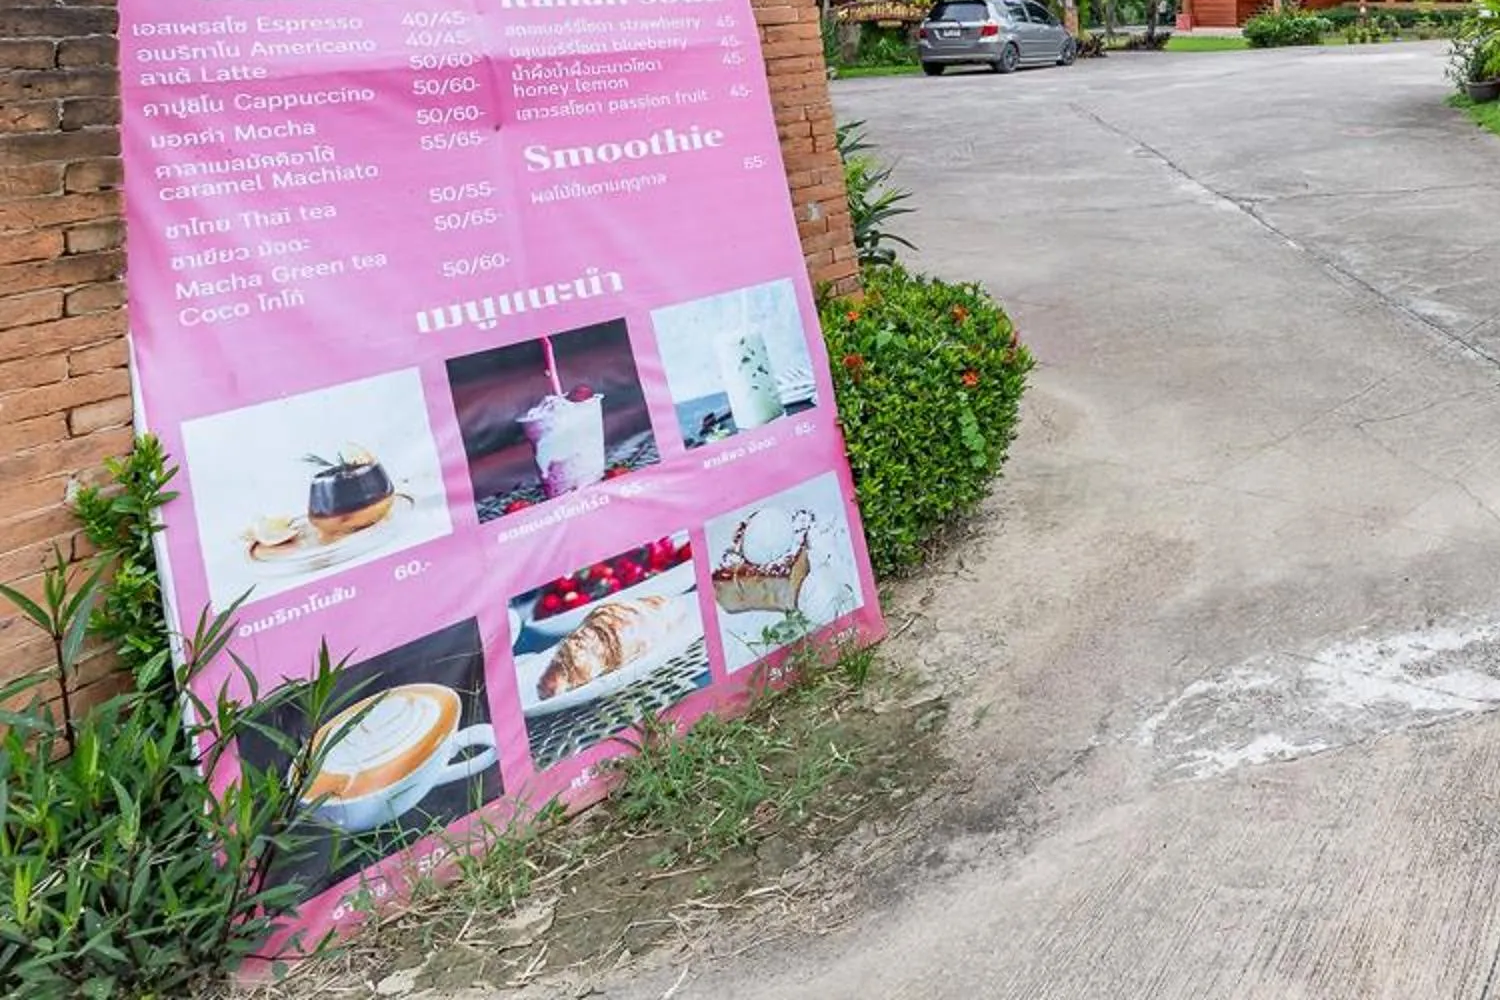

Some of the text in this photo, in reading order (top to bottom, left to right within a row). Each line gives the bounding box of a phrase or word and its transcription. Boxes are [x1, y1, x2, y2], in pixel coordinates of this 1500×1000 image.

[256, 15, 363, 36] Espresso
[137, 41, 241, 62] อเมริกาโน
[251, 38, 377, 57] Americano
[612, 36, 688, 53] blueberry
[201, 64, 268, 83] Latte
[234, 86, 375, 113] Cappuccino
[512, 77, 630, 98] honey lemon
[608, 92, 672, 114] passion
[675, 88, 709, 106] fruit
[233, 120, 317, 142] Mocha
[523, 124, 725, 173] Smoothie
[159, 163, 380, 202] caramel Machiato
[165, 216, 231, 240] ชาไทย
[240, 207, 293, 230] Thai
[299, 204, 338, 221] tea
[171, 246, 251, 271] ชาเขียว
[175, 250, 389, 301] Macha Green tea
[178, 302, 251, 327] Coco
[256, 288, 306, 313] โกโก้
[415, 267, 625, 334] เมนูแนะนำ
